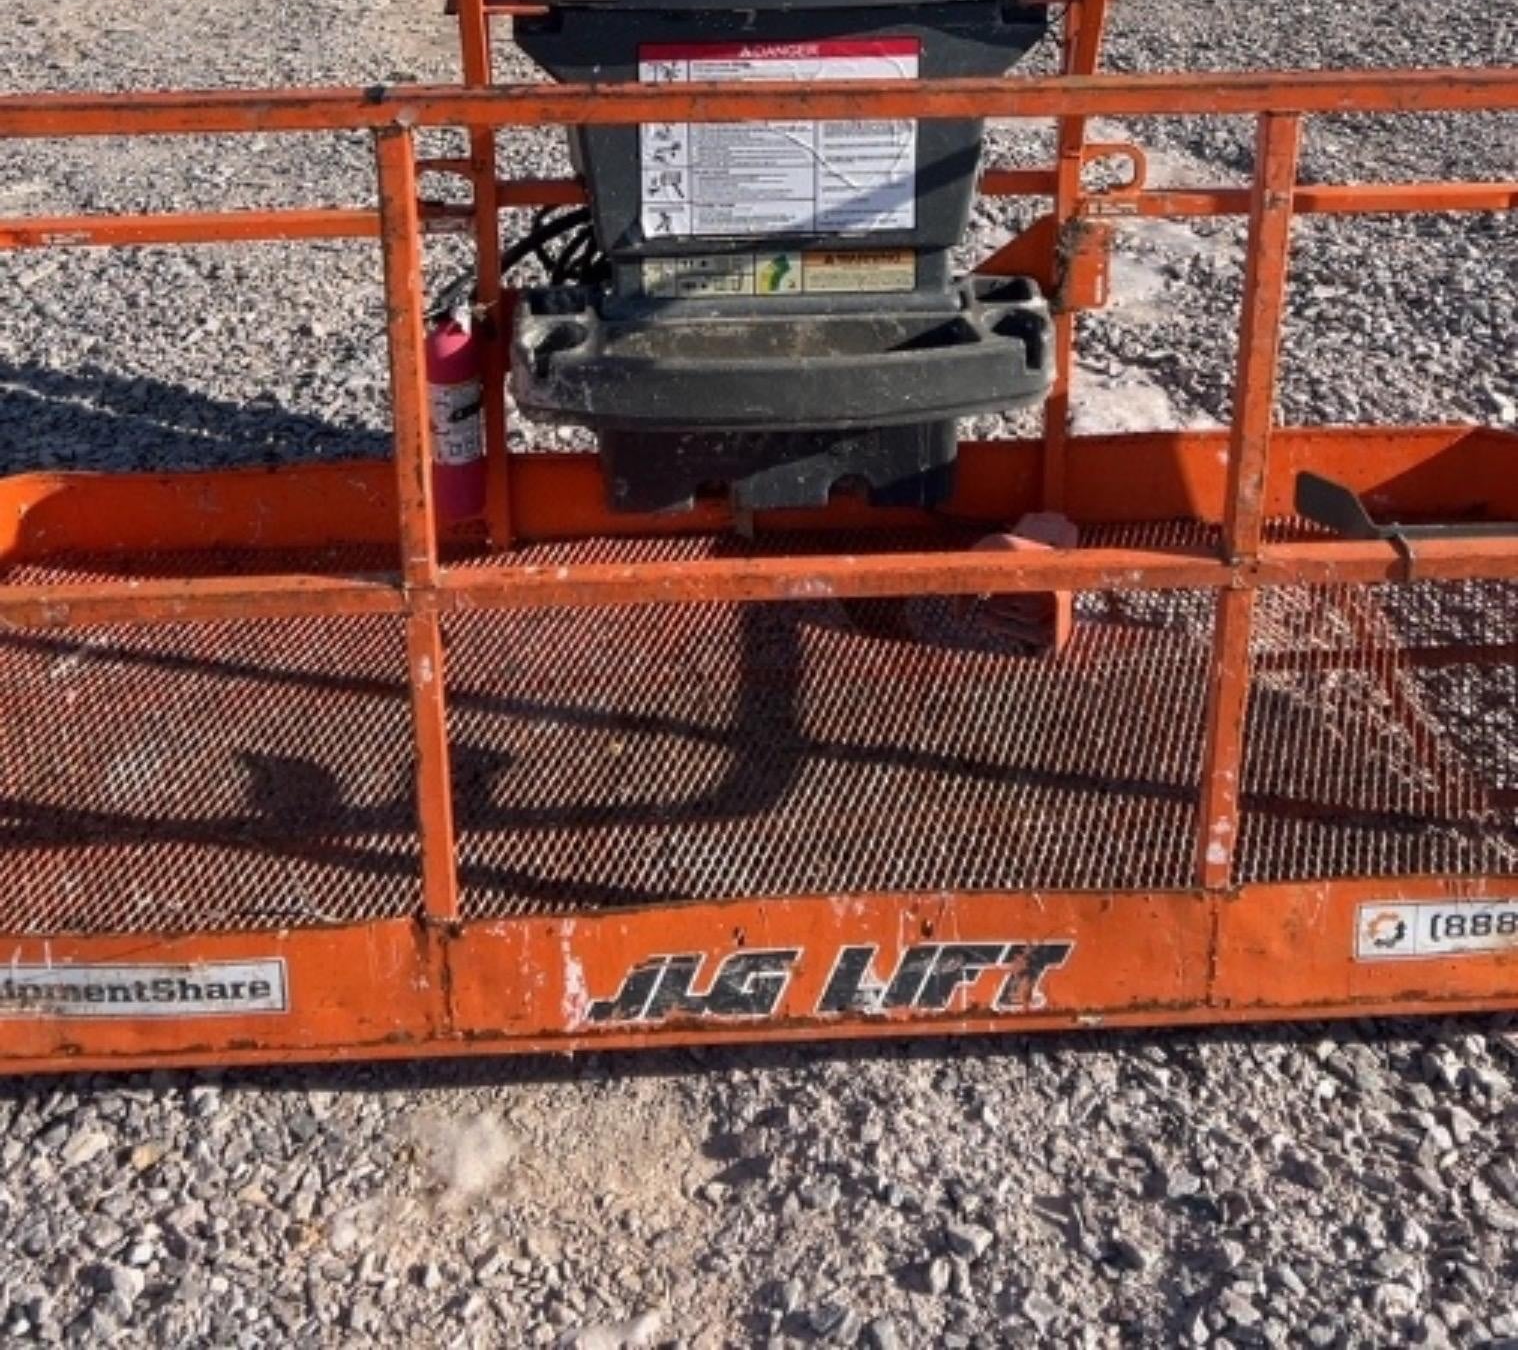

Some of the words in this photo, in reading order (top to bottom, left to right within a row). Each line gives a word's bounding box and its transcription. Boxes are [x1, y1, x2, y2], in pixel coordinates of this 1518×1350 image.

[752, 43, 818, 59] DANGER
[1430, 911, 1518, 942] (888
[0, 977, 271, 1008] ipmentShare
[585, 948, 803, 1024] JLG
[812, 941, 1075, 1015] LIFT
